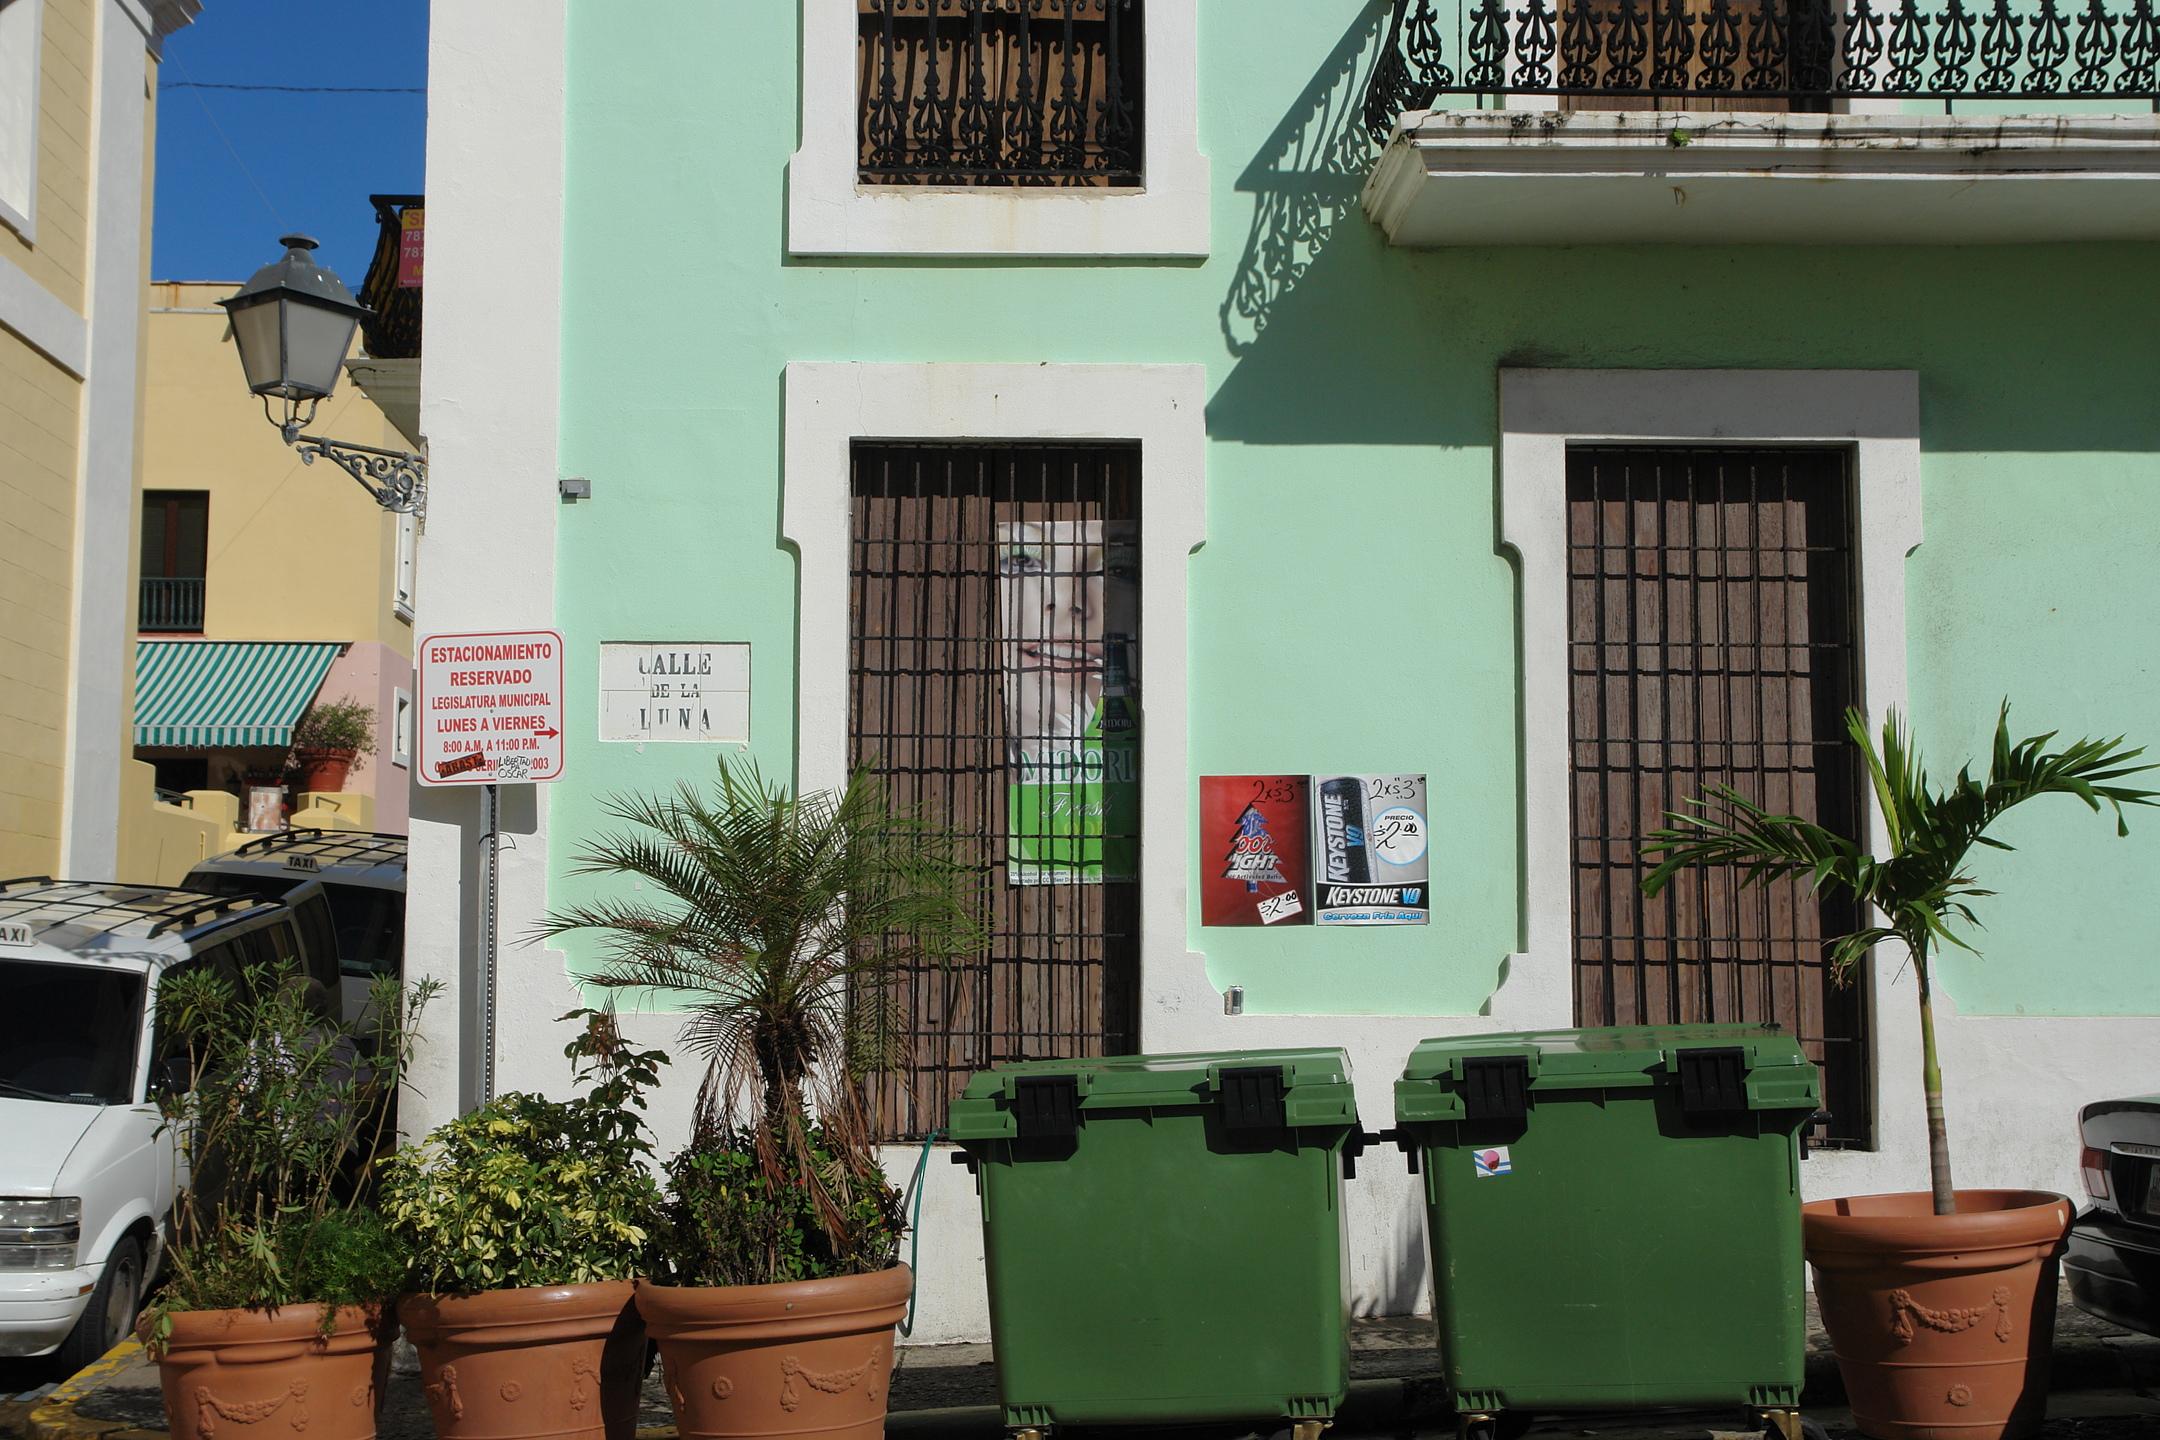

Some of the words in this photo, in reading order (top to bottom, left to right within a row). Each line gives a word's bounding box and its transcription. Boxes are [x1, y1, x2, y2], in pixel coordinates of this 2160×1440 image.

[431, 643, 552, 663] ESTACIONAMIENTO
[638, 652, 712, 675] CALLE
[450, 669, 532, 686] RESERVADO
[650, 683, 670, 699] DE
[680, 683, 701, 698] LA
[432, 694, 497, 710] LEGISLATURA
[499, 692, 551, 708] MUNICIPAL
[437, 718, 477, 733] LUNES
[480, 717, 489, 731] A
[493, 715, 545, 730] VIERNES
[639, 708, 711, 731] LUNA
[443, 740, 462, 753] 8:00
[465, 740, 484, 753] A.M.
[486, 740, 493, 751] A
[496, 739, 520, 751] 11:00
[522, 738, 540, 751] P.M.
[498, 755, 531, 769] LIBERTAD
[530, 757, 549, 770] 003
[1019, 748, 1136, 784] MIDORI
[498, 768, 528, 779] OSCAR
[1324, 793, 1350, 882] KEYSTONE
[288, 856, 314, 869] TAXI
[1325, 886, 1401, 906] KEYSTONE
[1323, 911, 1370, 920] Cerveza
